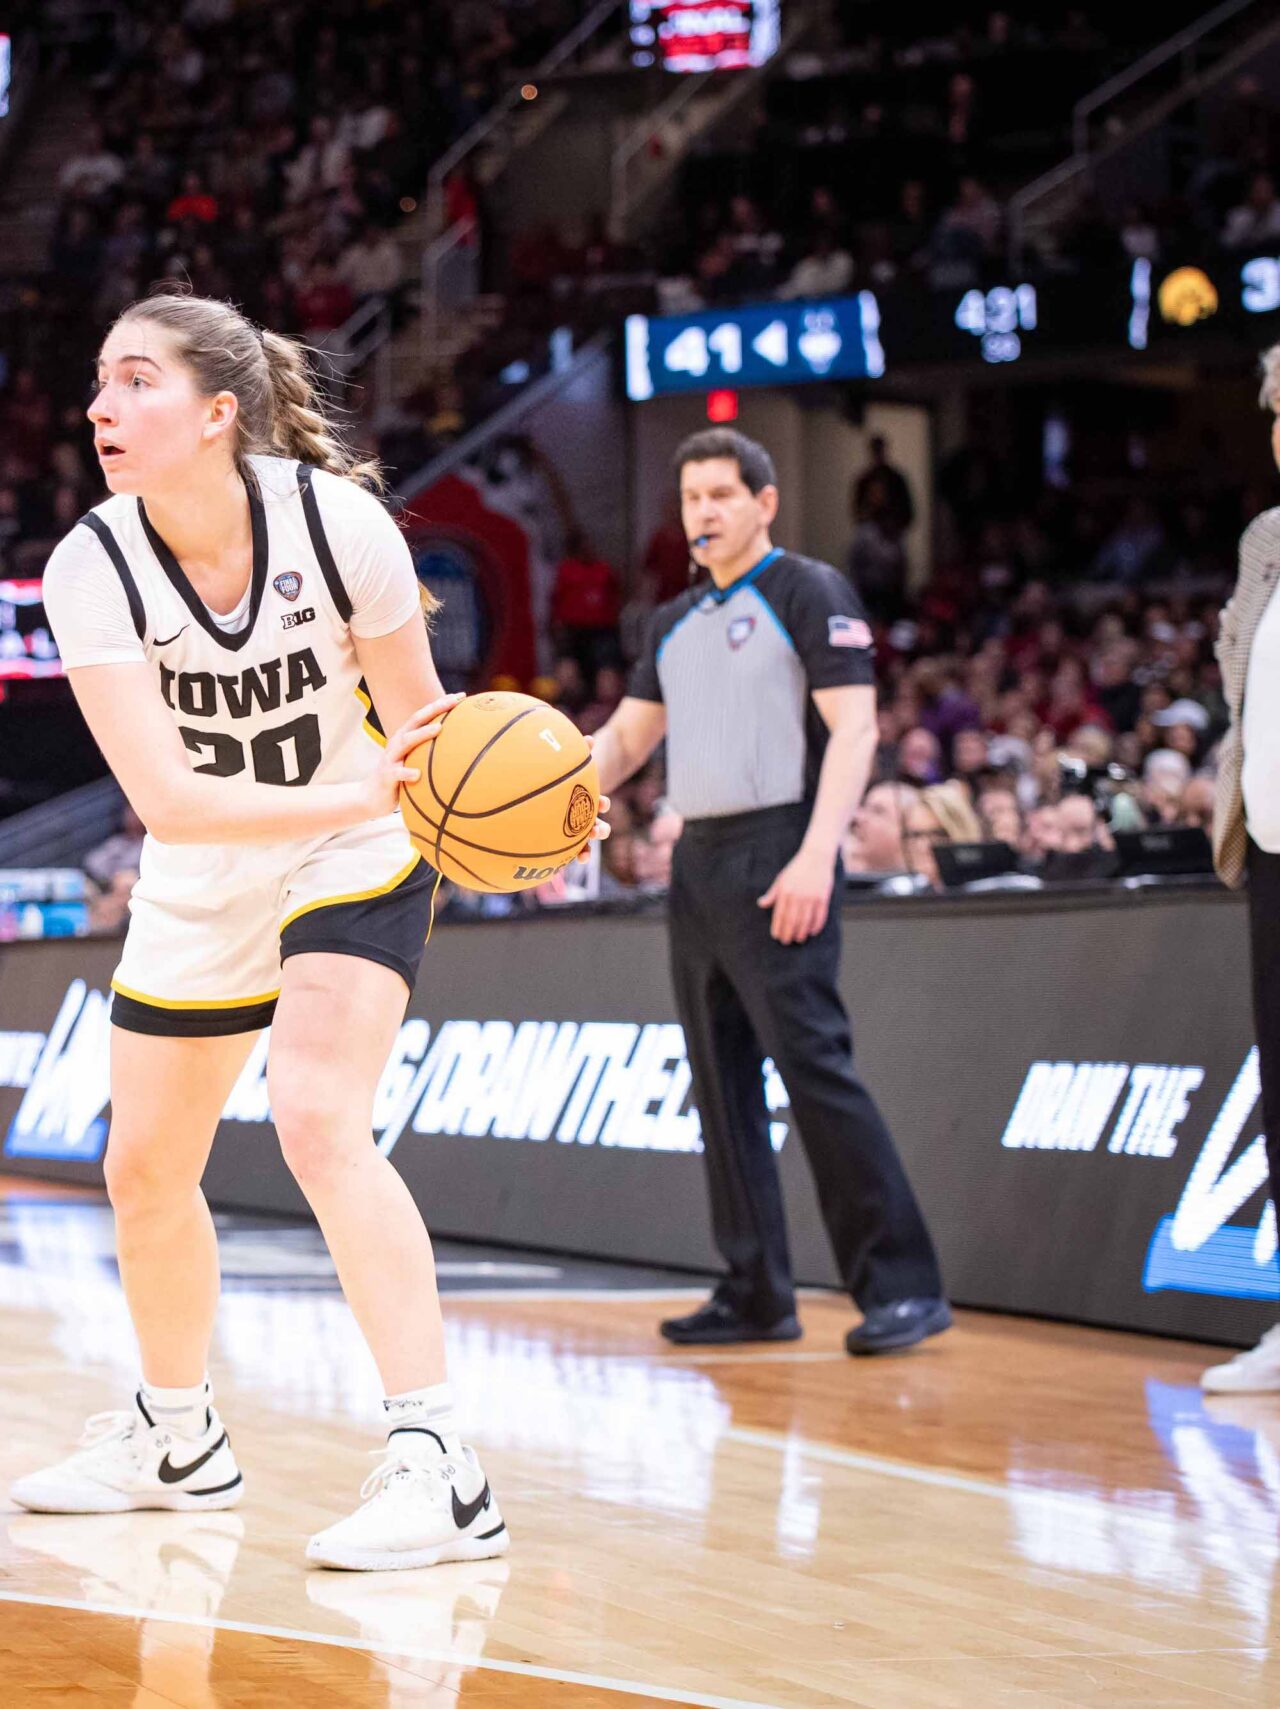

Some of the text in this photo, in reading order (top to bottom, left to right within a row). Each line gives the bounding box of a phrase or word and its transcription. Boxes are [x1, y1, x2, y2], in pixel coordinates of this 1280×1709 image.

[664, 322, 742, 377] 41
[159, 647, 327, 719] IOWA
[1108, 1063, 1206, 1157] THE
